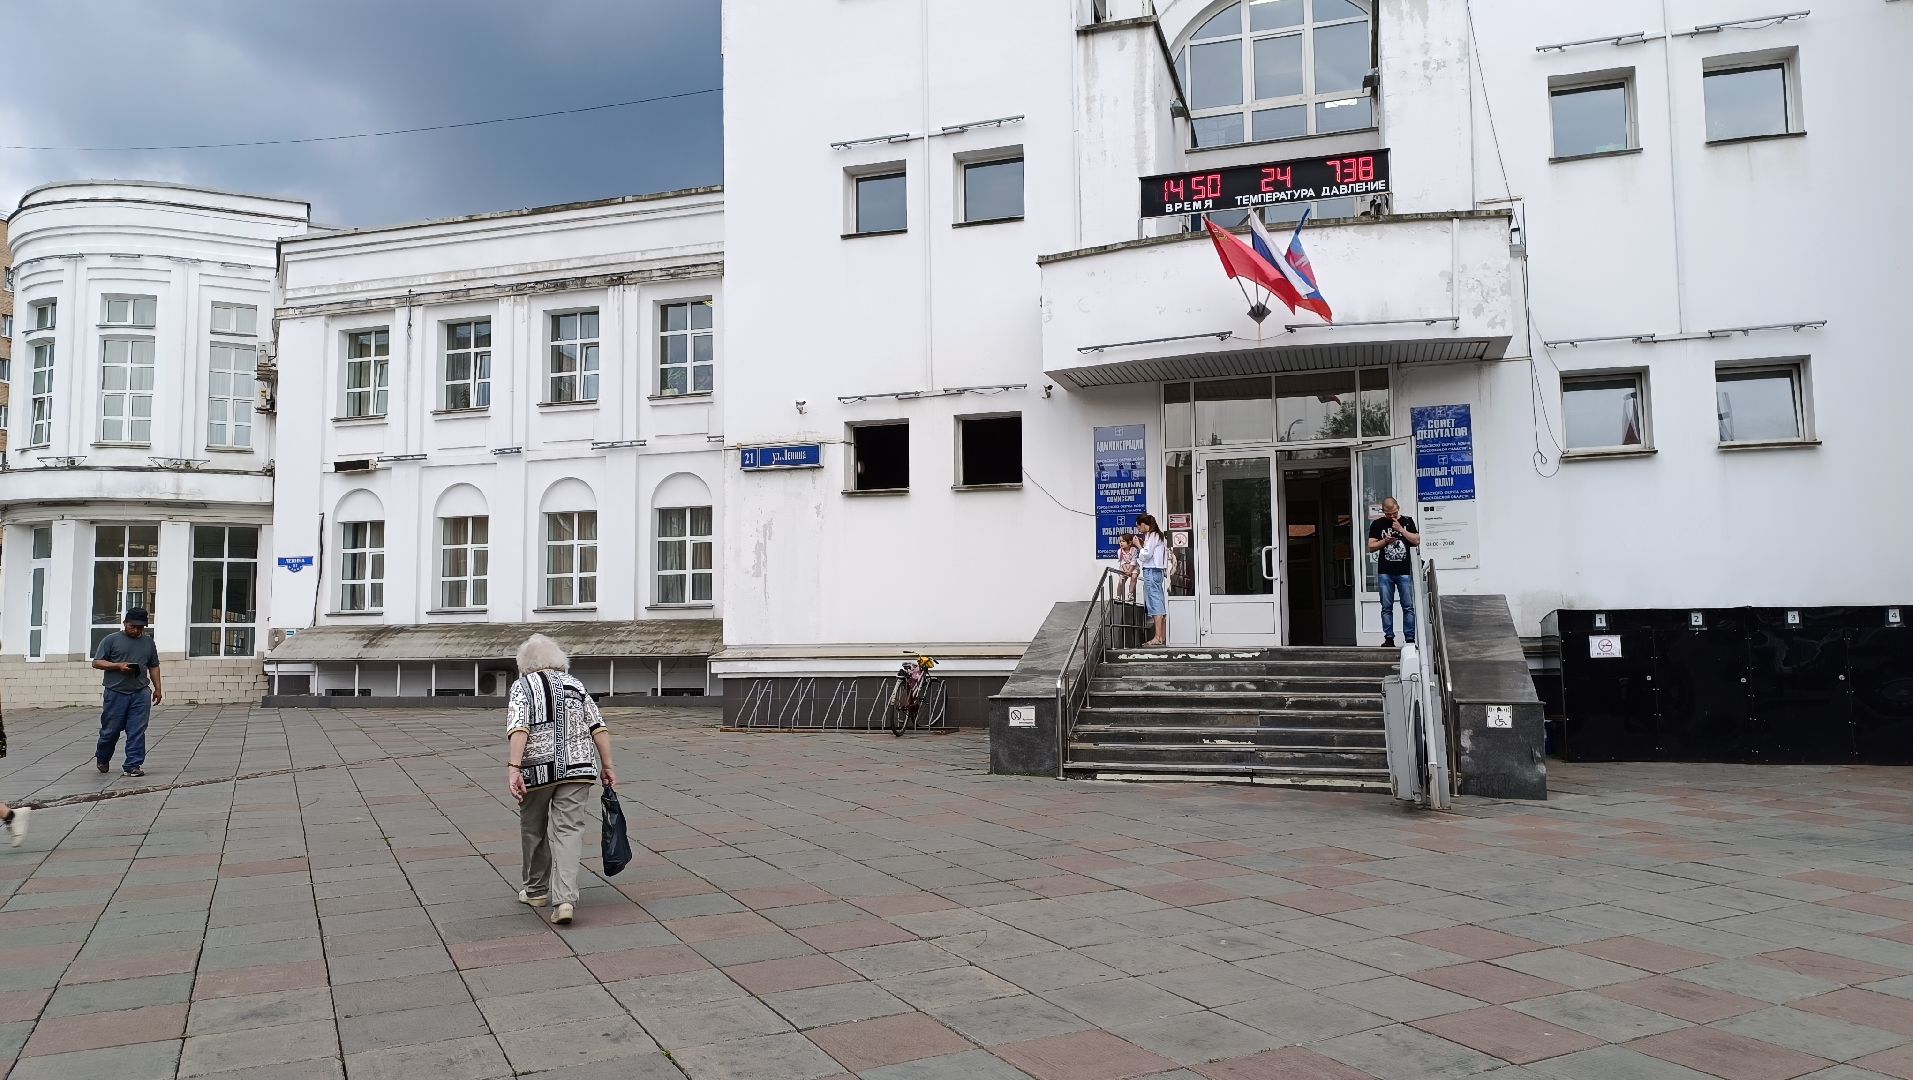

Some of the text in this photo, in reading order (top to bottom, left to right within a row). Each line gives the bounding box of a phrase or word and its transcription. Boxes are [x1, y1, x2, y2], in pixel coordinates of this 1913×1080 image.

[1164, 157, 1374, 201] 14 50 24 738
[1165, 180, 1386, 212] ВРЕМЯ ТЕМПЕРАТУРА ДАВЛЕНИЕ
[1427, 418, 1456, 428] СОВЕТ
[1416, 427, 1468, 440] ДЕПУТАТОВ
[1096, 439, 1144, 452] АДМИНИСТРАЦИЯ
[745, 452, 754, 464] 21
[1693, 615, 1700, 623] 2
[1790, 614, 1796, 622] 3
[1891, 612, 1898, 620] 4
